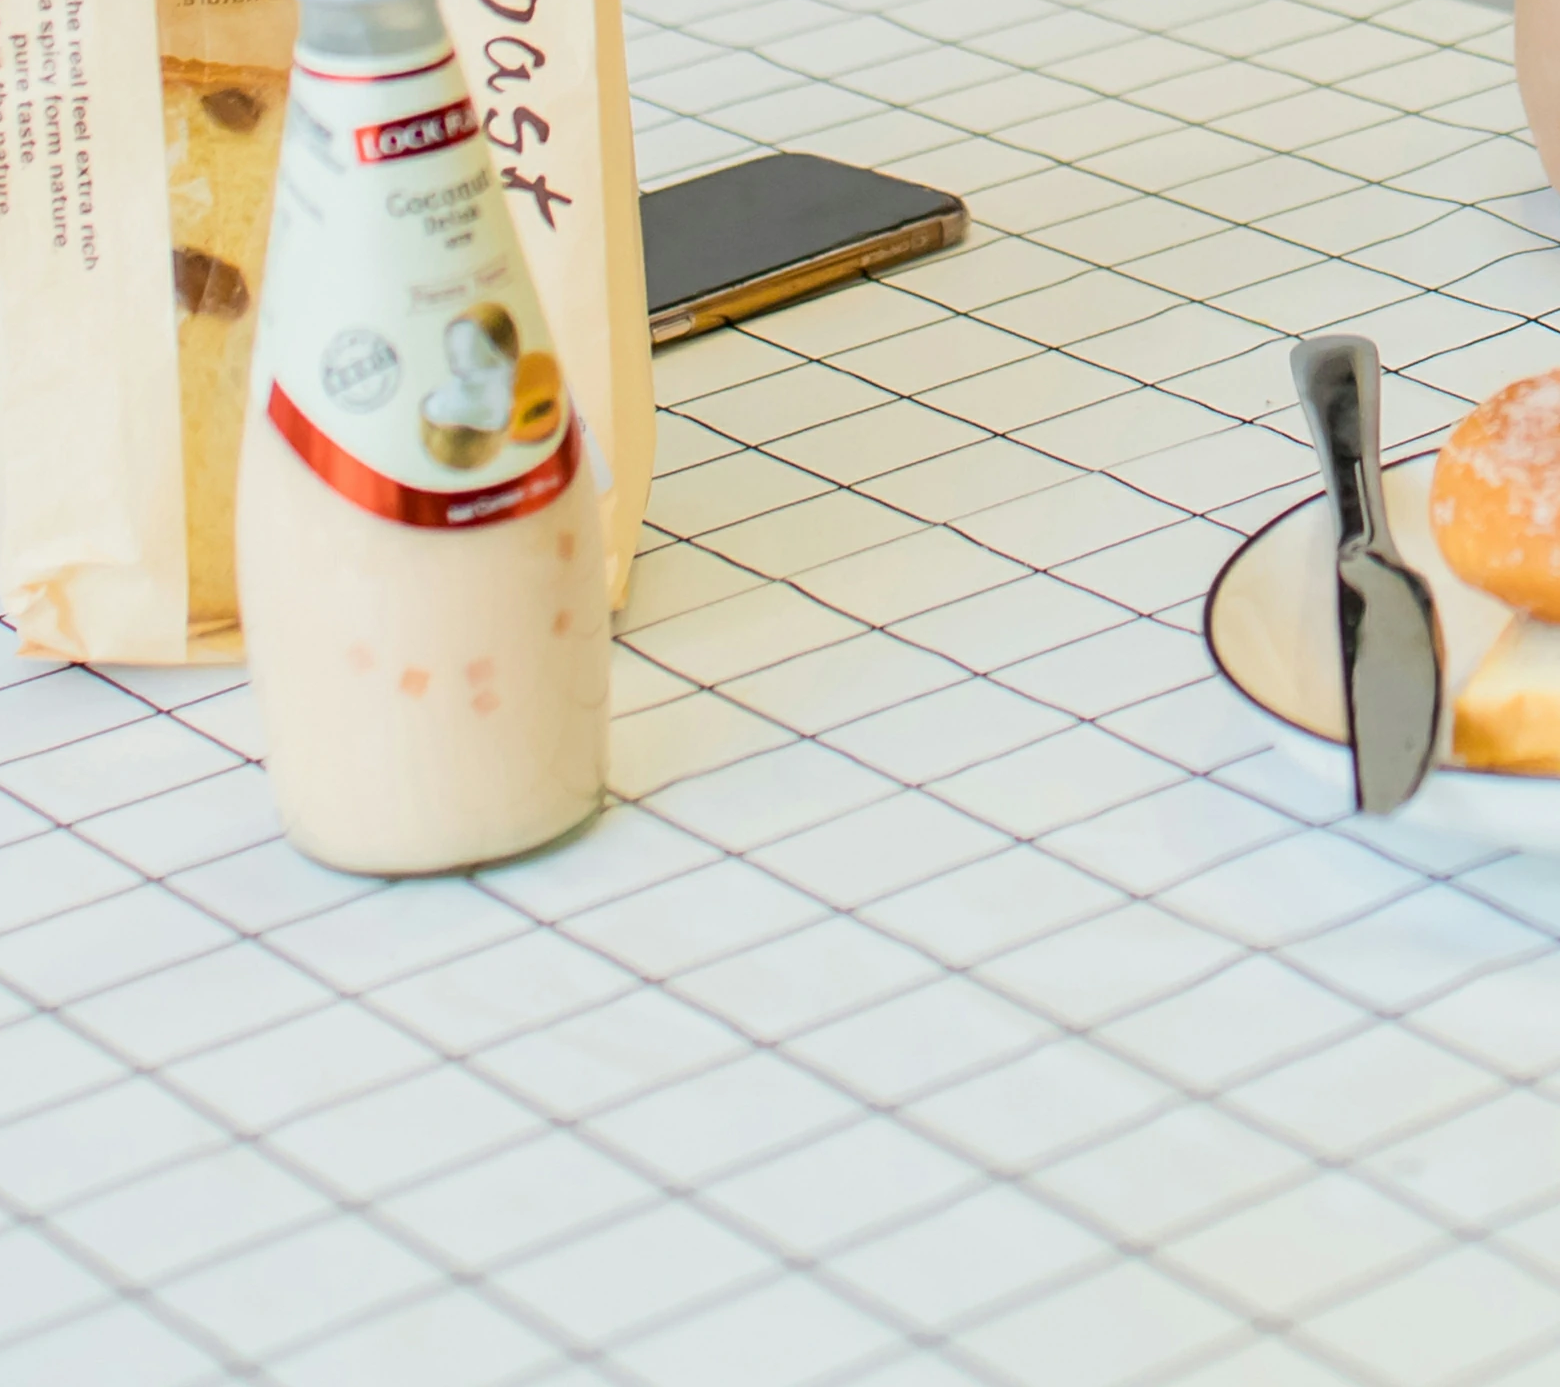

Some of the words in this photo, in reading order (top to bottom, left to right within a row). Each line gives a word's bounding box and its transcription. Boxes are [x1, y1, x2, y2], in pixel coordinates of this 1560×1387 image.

[9, 33, 29, 91] pure
[36, 20, 59, 85] spicy
[69, 40, 88, 88] real
[44, 94, 63, 155] form
[72, 95, 92, 142] feel
[76, 150, 94, 215] extra
[81, 224, 99, 271] rich
